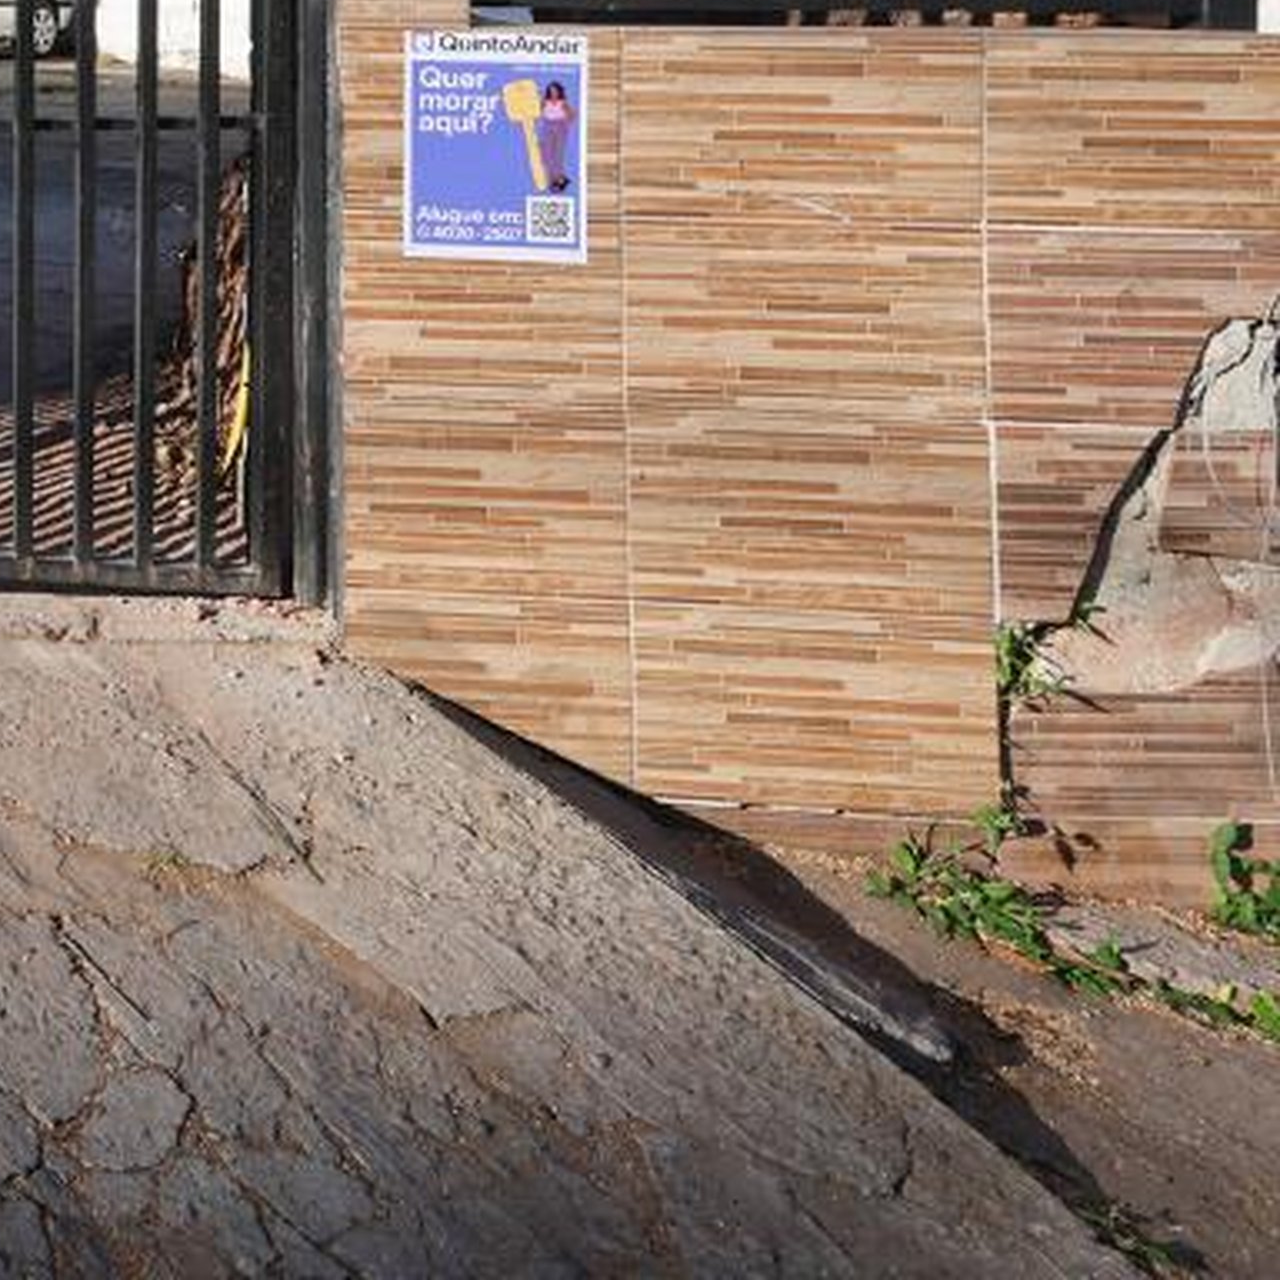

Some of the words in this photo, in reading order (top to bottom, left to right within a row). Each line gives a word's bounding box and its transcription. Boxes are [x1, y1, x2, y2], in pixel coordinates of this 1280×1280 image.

[439, 33, 580, 54] QuintoAndar
[419, 66, 488, 89] Quer
[419, 93, 500, 112] morar
[419, 111, 494, 137] aqui?
